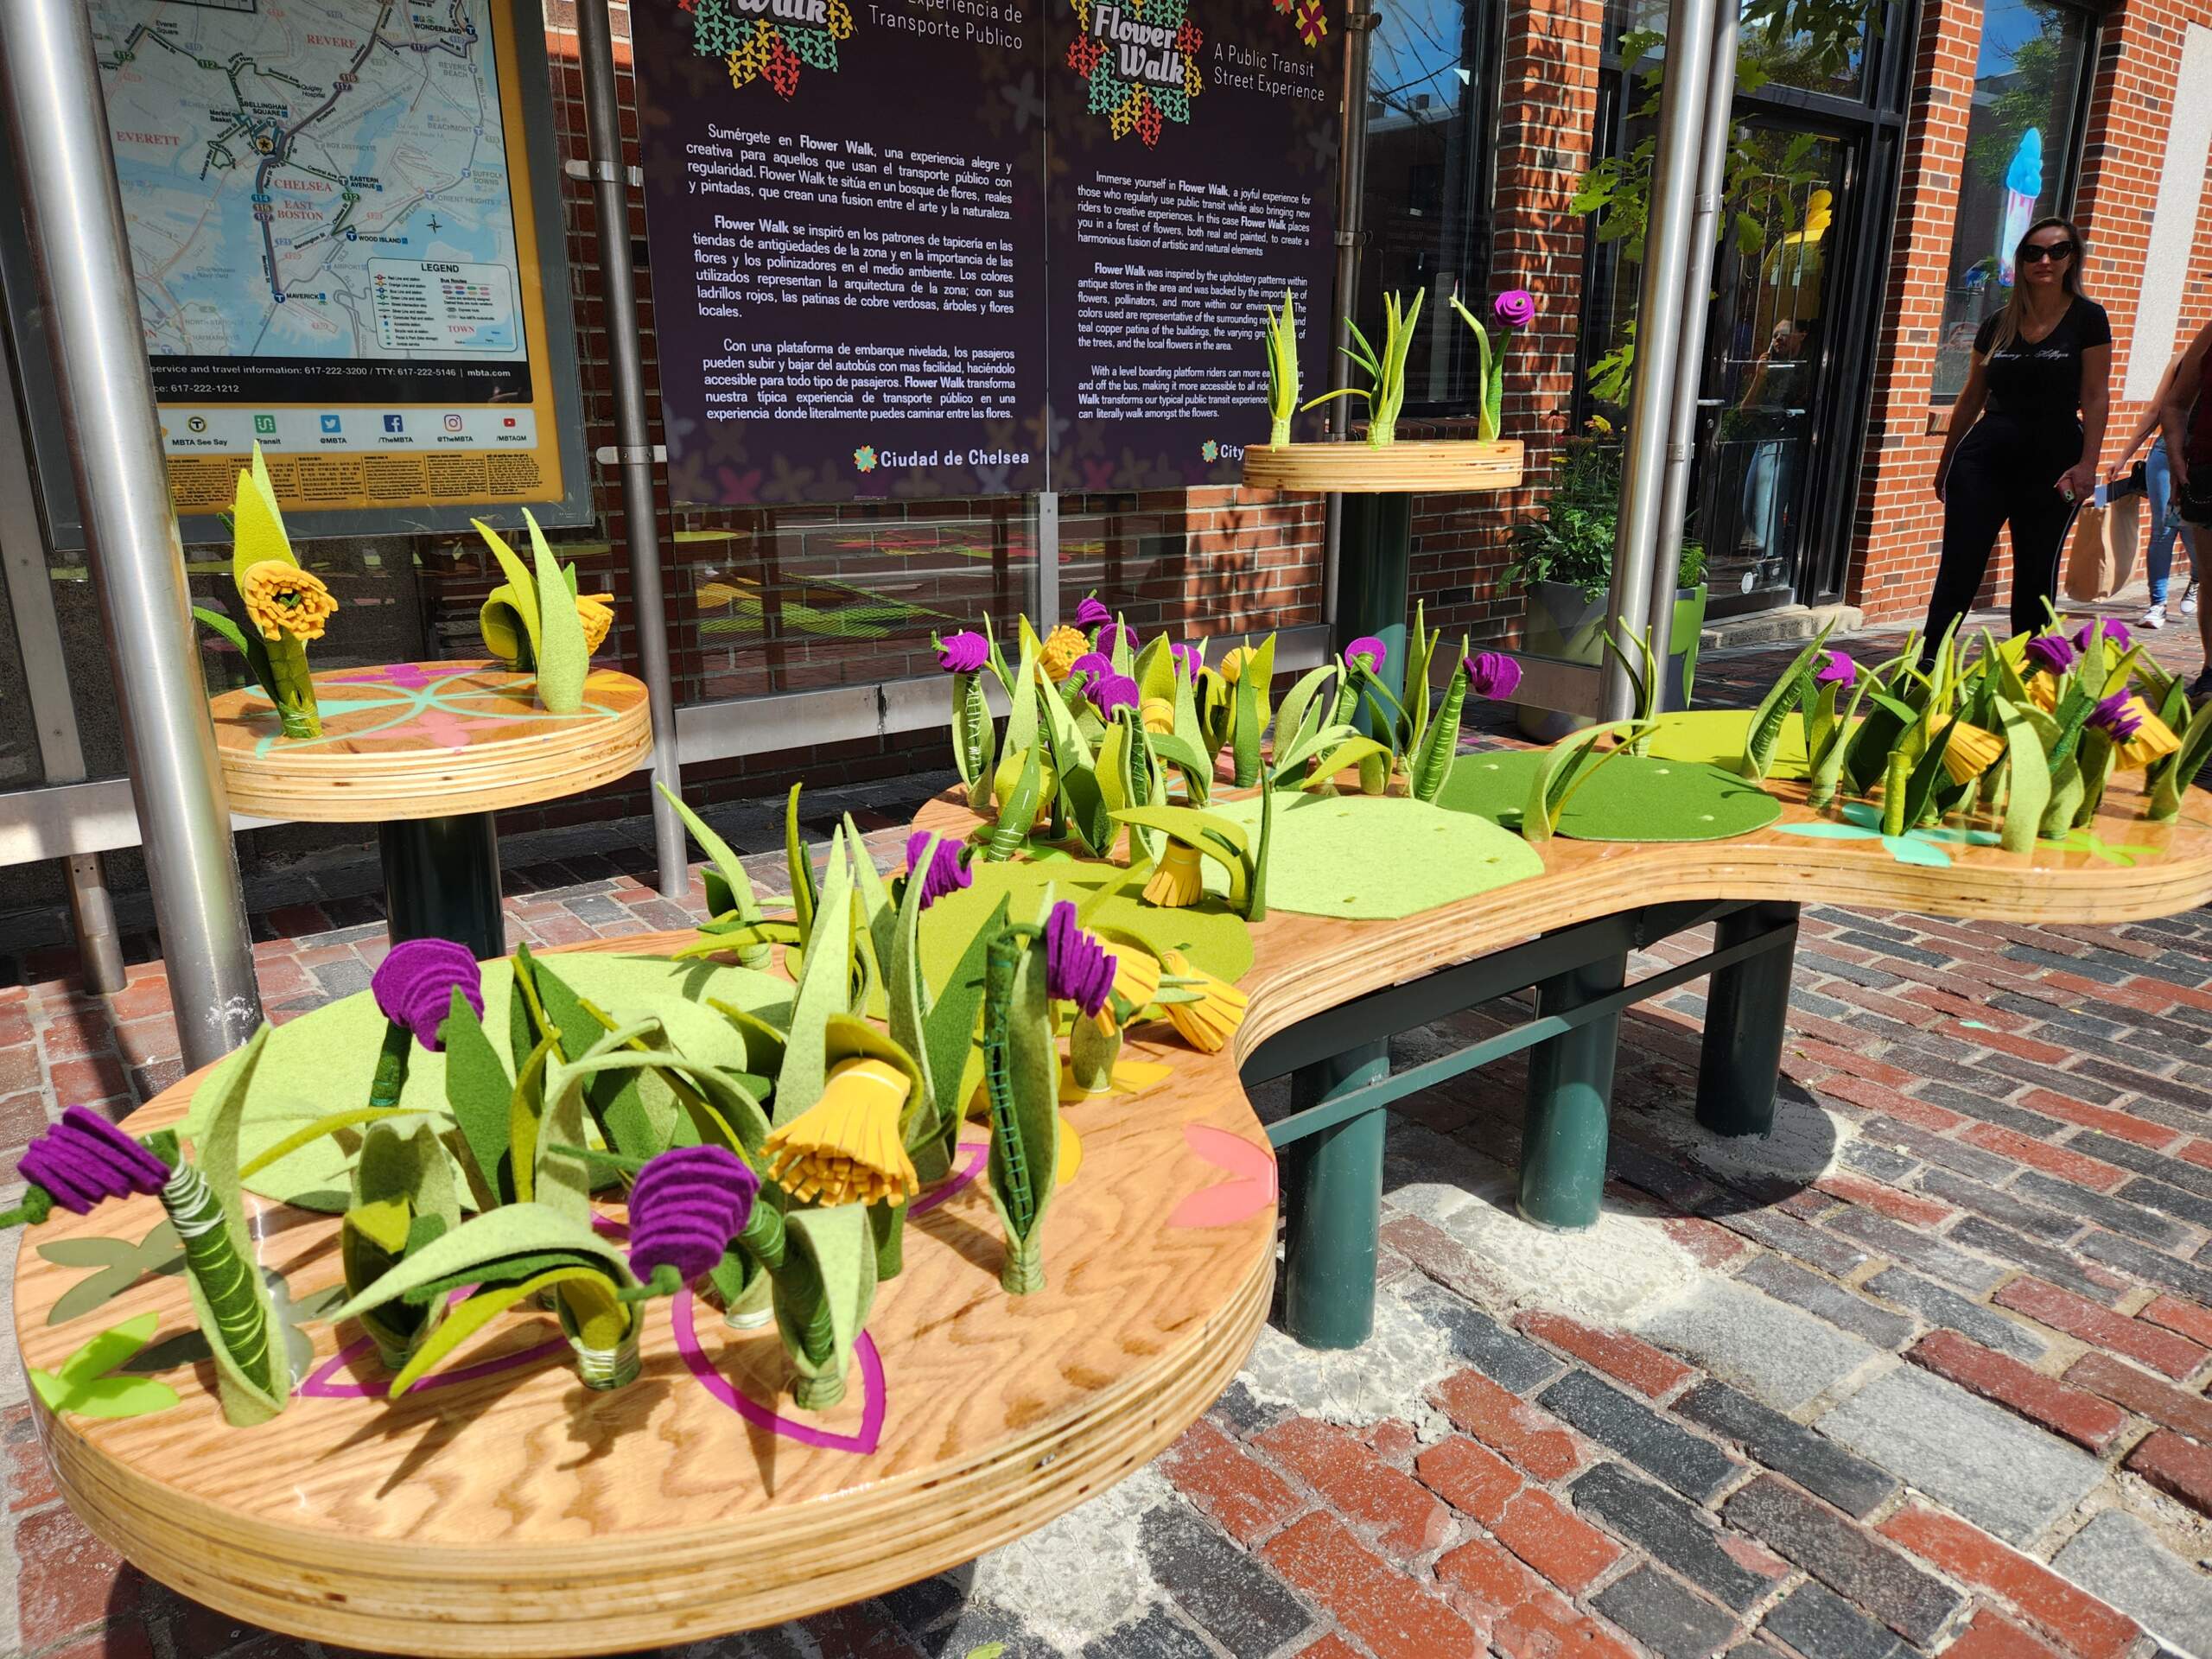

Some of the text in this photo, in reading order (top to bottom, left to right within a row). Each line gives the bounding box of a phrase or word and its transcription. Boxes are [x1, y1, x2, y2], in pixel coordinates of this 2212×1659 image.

[1004, 3, 1022, 23] de
[413, 22, 461, 35] WONDERLAND
[868, 4, 1022, 49] Transporte Publico
[1094, 3, 1177, 48] Flower
[307, 35, 357, 48] REVERE
[1120, 44, 1184, 85] Walk
[1214, 43, 1314, 78] A Public Transit
[1214, 66, 1325, 102] Street Experience
[245, 102, 288, 111] BELLINGHAM
[116, 131, 180, 146] EVERETT
[708, 123, 1012, 175] Sumérgete en Flower Walk, una experiencia alegre y
[686, 143, 1012, 188] creativa para aquellos que usan el transporte público con
[274, 180, 332, 192] CHELSEA
[349, 175, 378, 183] EASTERN
[687, 160, 1013, 204] regularidad. Flower Walk te sitúa en un bosque de flores, reales
[1096, 170, 1132, 186] Immerse
[1134, 178, 1166, 189] yourself
[1168, 179, 1176, 190] in
[1179, 180, 1205, 194] Flower
[1208, 182, 1230, 197] Walk,
[1239, 188, 1260, 201] joyful
[1262, 192, 1299, 204] experience
[1301, 194, 1311, 205] for
[284, 200, 313, 209] EAST
[688, 179, 1012, 219] y pintadas, que crean una fusion entre el arte y la naturaleza.
[277, 210, 323, 220] BOSTON
[1077, 230, 1263, 256] harmonious fusion of artistic and natural elements
[422, 263, 460, 273] LEGEND
[723, 338, 1014, 361] Con una plataforma de embarque nivelada, los pasajeros
[243, 365, 302, 374] information:
[304, 366, 367, 375] 617-222-3200
[397, 367, 456, 377] 617-222-5146
[170, 384, 239, 392] 617-222-1212
[1096, 407, 1124, 421] literally
[1125, 407, 1143, 418] walk
[1144, 408, 1177, 420] amongst
[1178, 407, 1191, 417] the
[1191, 406, 1219, 417] flowers.
[880, 448, 1029, 467] Ciudad de Chelsea
[1220, 444, 1244, 461] City
